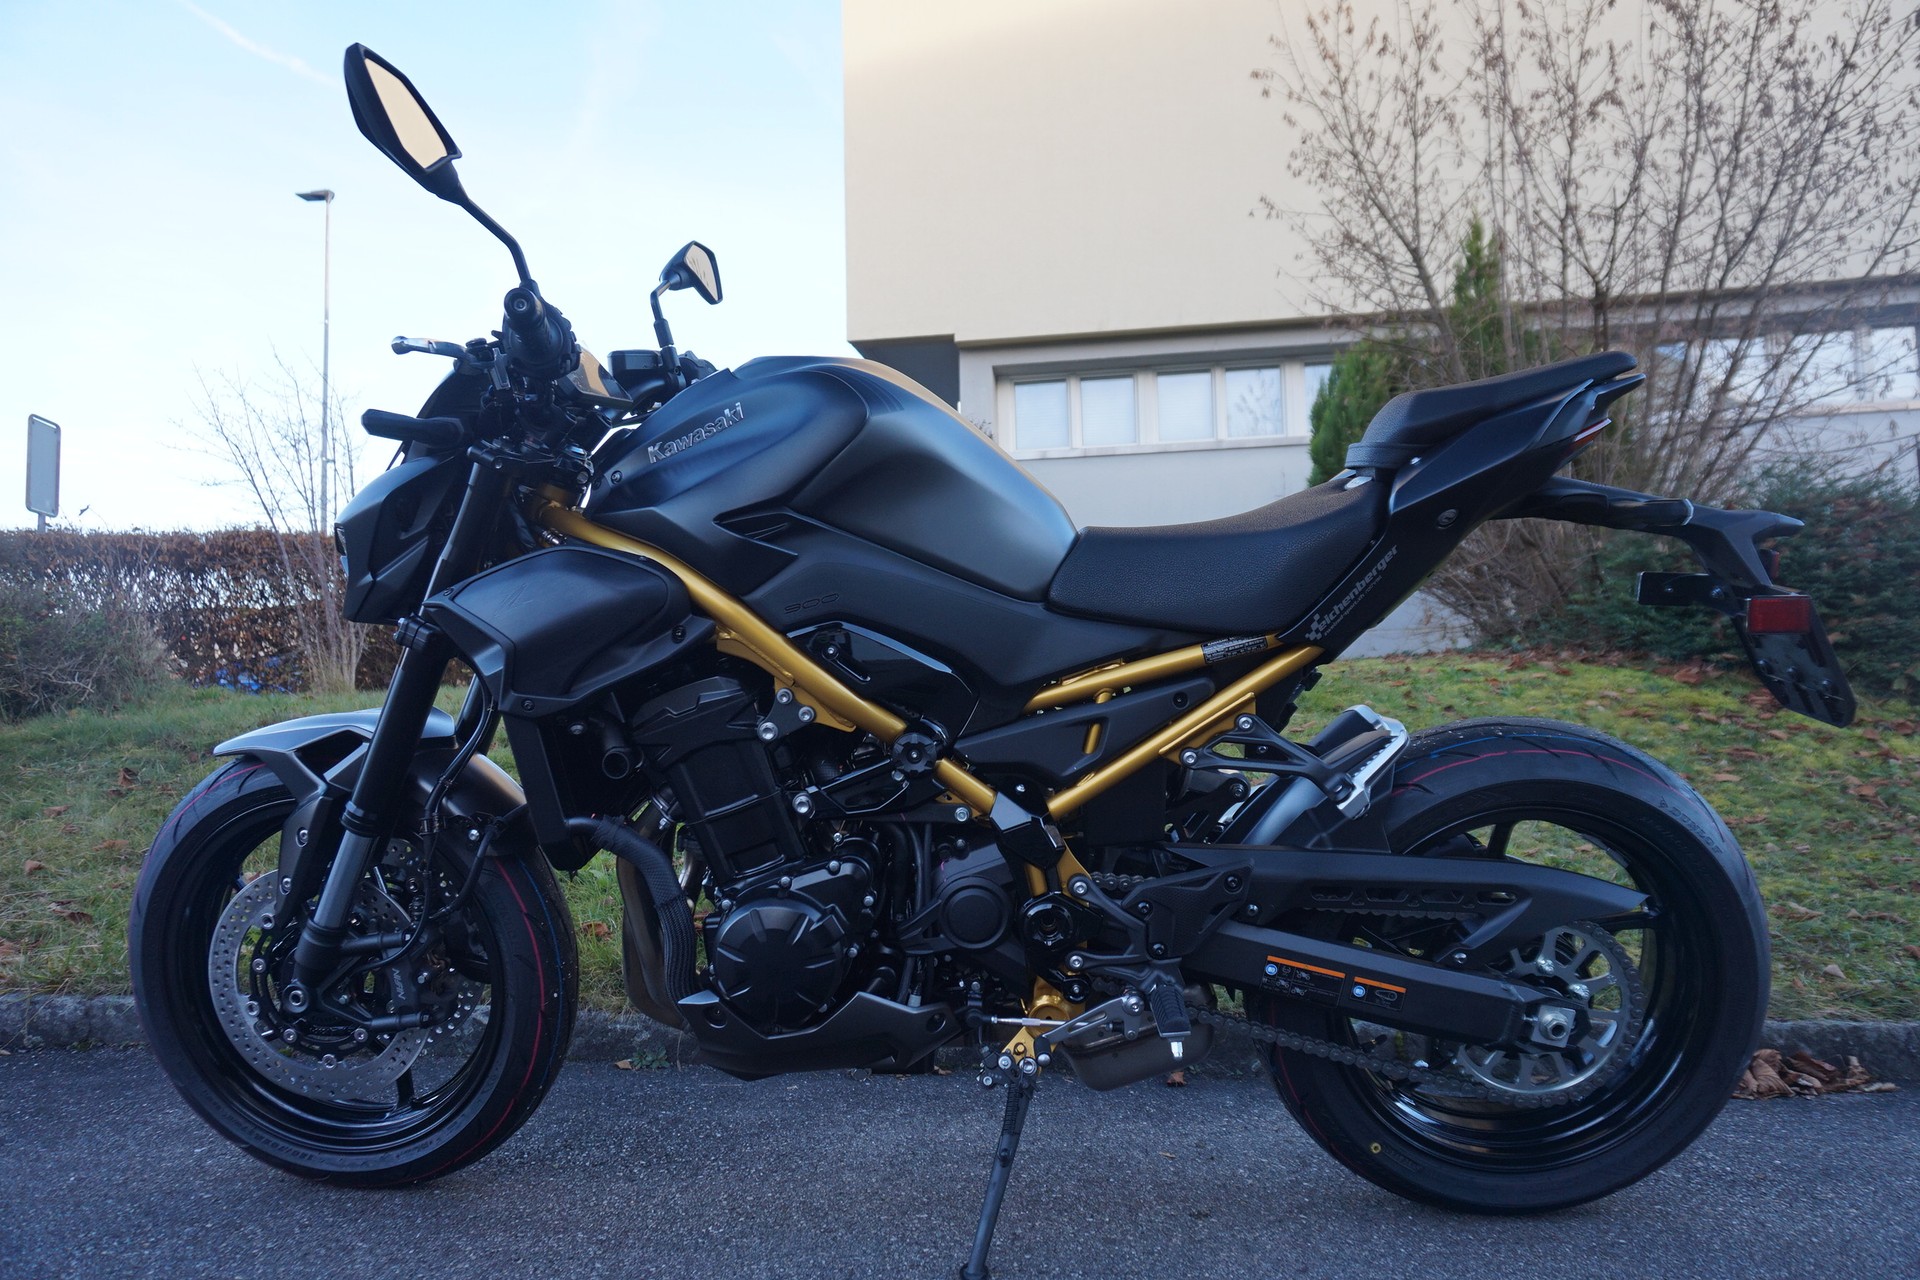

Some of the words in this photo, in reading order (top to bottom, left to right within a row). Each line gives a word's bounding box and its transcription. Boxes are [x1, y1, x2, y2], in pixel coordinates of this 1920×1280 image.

[648, 402, 744, 464] Kawasaki
[784, 593, 840, 614] 900
[1318, 545, 1398, 632] eichenberger
